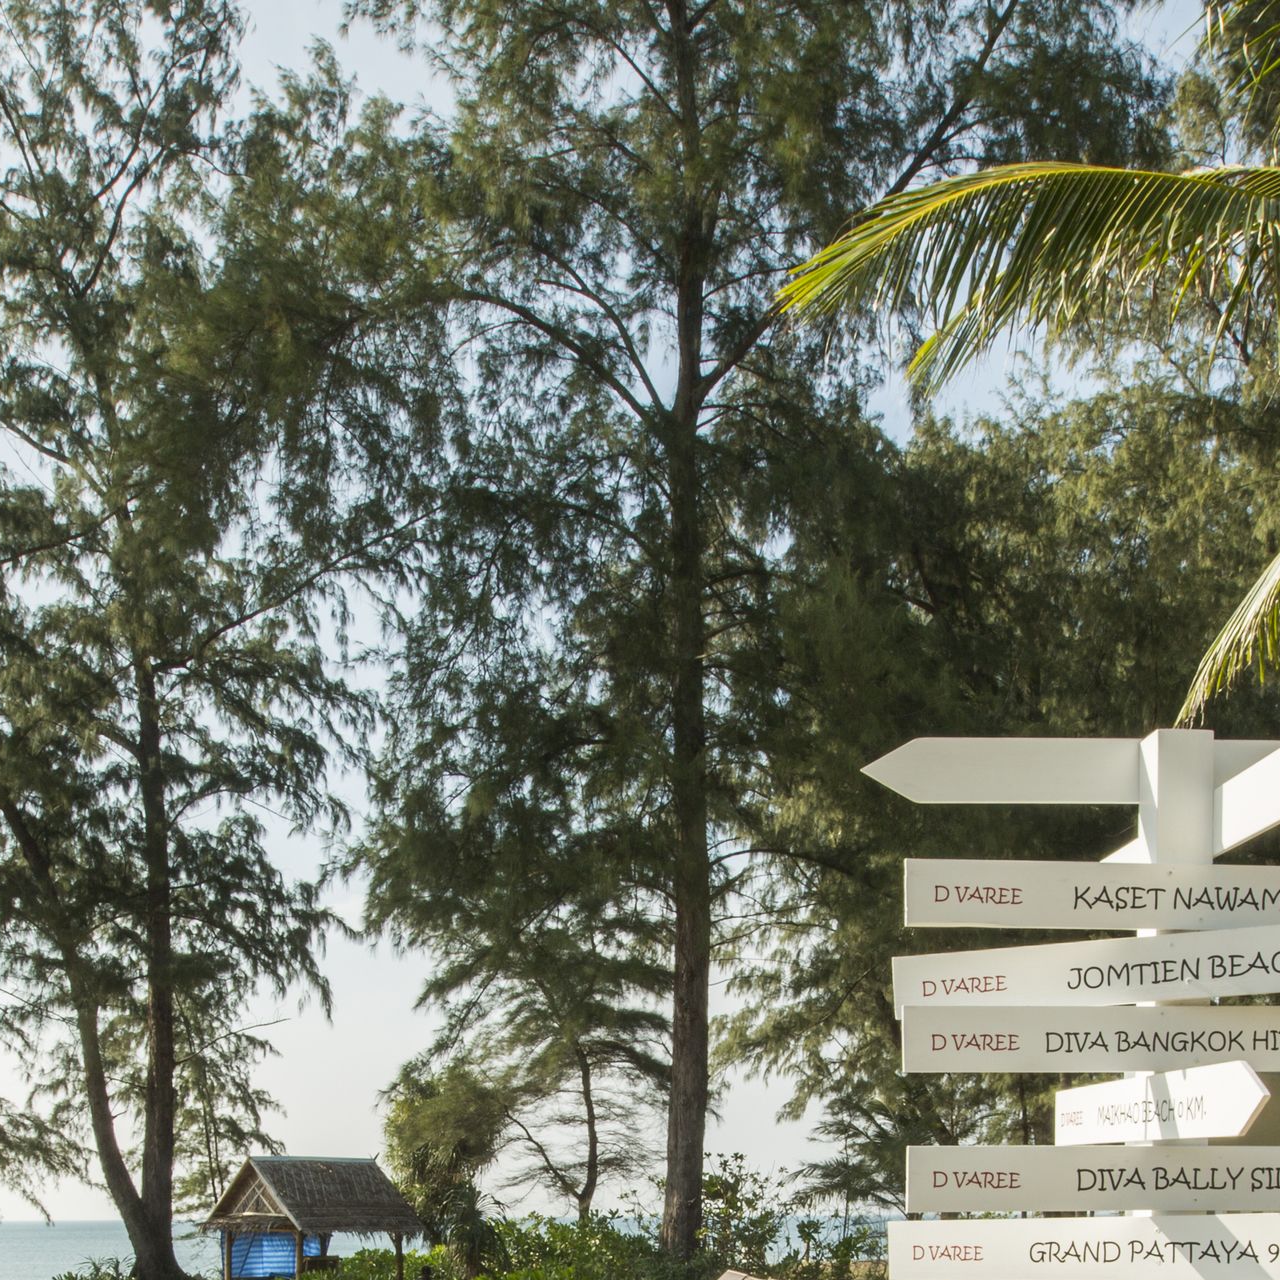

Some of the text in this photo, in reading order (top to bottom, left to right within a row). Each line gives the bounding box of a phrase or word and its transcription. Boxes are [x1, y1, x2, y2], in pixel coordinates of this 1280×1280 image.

[935, 885, 950, 903] D
[954, 886, 1023, 904] VAREE
[1074, 885, 1166, 912] KASET
[922, 981, 937, 997] D
[941, 975, 1008, 995] VAREE
[1067, 957, 1202, 990] JOMTIEN
[932, 1034, 947, 1051] D
[951, 1033, 1020, 1051] VAREE
[1045, 1031, 1109, 1053] DIVA
[1114, 1030, 1245, 1053] BANGKOK
[1141, 1099, 1175, 1122] BEACH
[1186, 1095, 1207, 1121] KM.
[933, 1171, 948, 1188] D
[952, 1171, 1021, 1189] VAREE
[1077, 1167, 1146, 1192] DIVA
[1152, 1167, 1244, 1191] BALLY
[913, 1245, 925, 1260] D
[928, 1245, 984, 1261] VAREE
[1029, 1240, 1121, 1263] GRAND
[1128, 1240, 1259, 1264] PATTAYA
